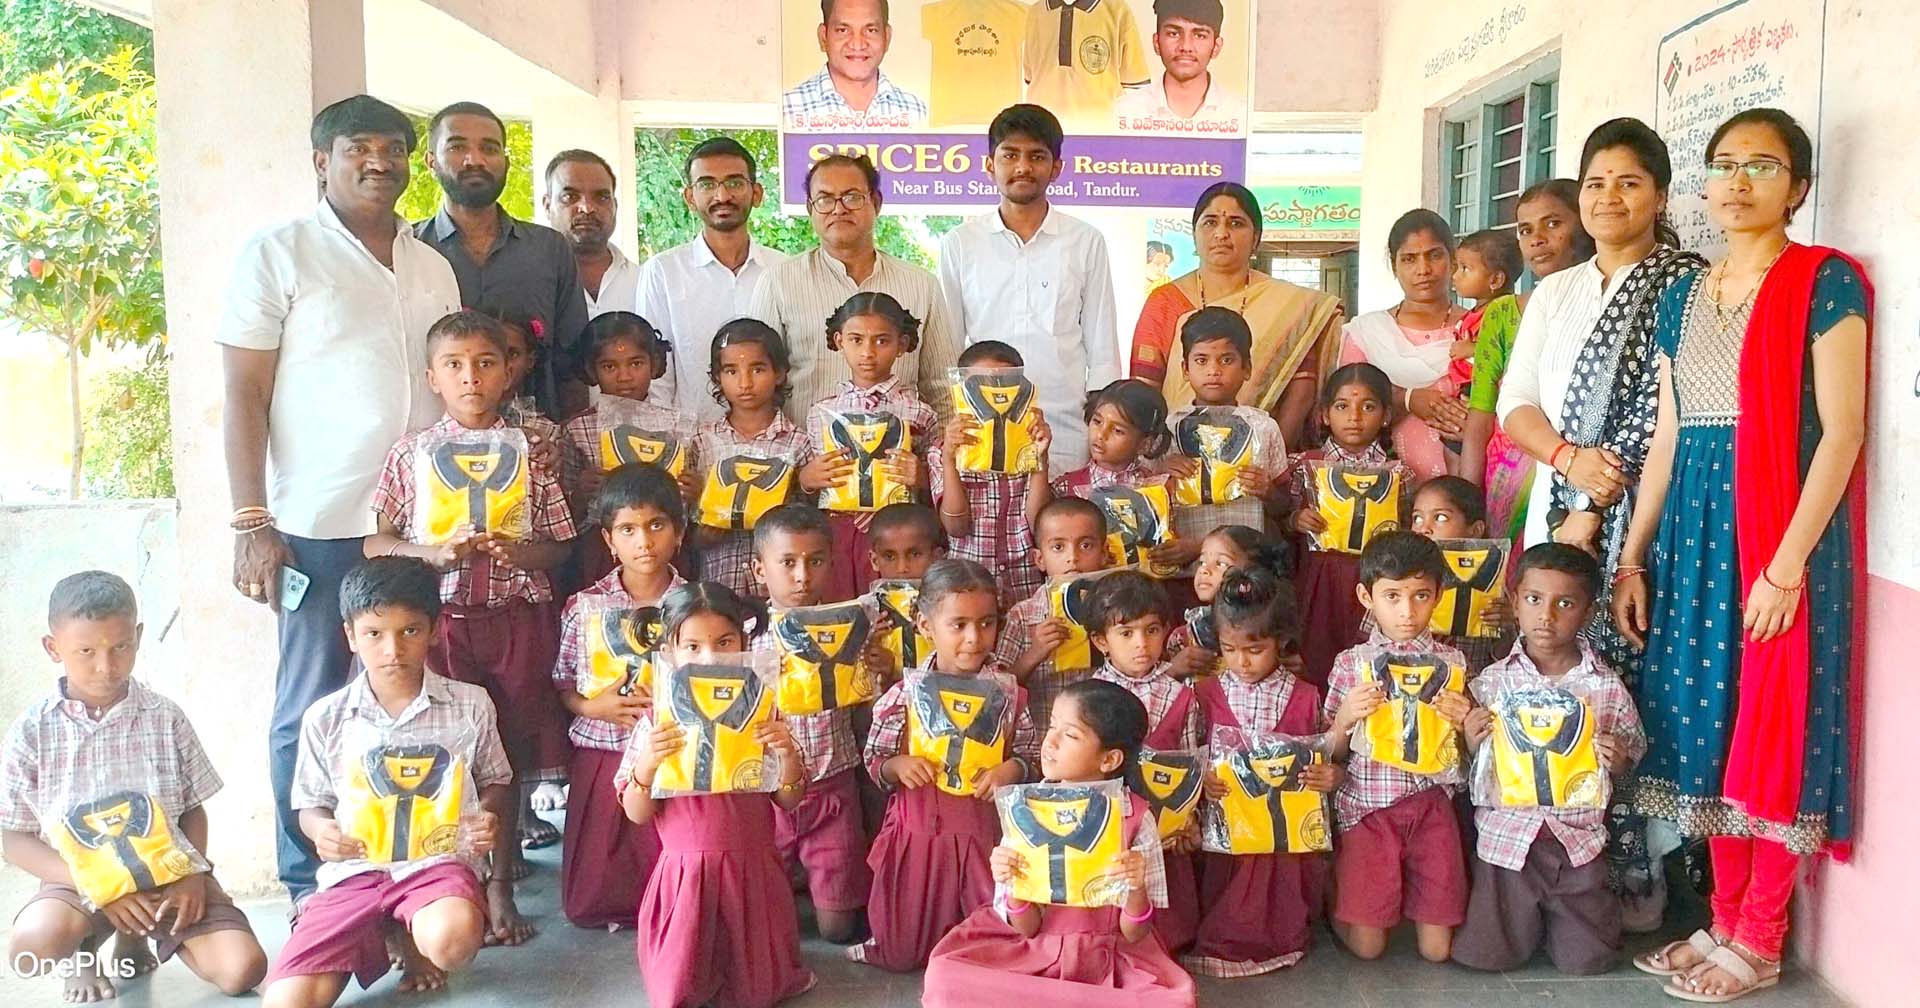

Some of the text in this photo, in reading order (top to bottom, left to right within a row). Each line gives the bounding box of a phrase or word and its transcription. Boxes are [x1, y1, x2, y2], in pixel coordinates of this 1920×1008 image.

[1073, 155, 1223, 177] Restaurants
[892, 180, 930, 196] Near
[934, 180, 963, 196] Bus
[1084, 182, 1140, 198] Tandur.
[1262, 199, 1361, 228] సుస్వాగతం
